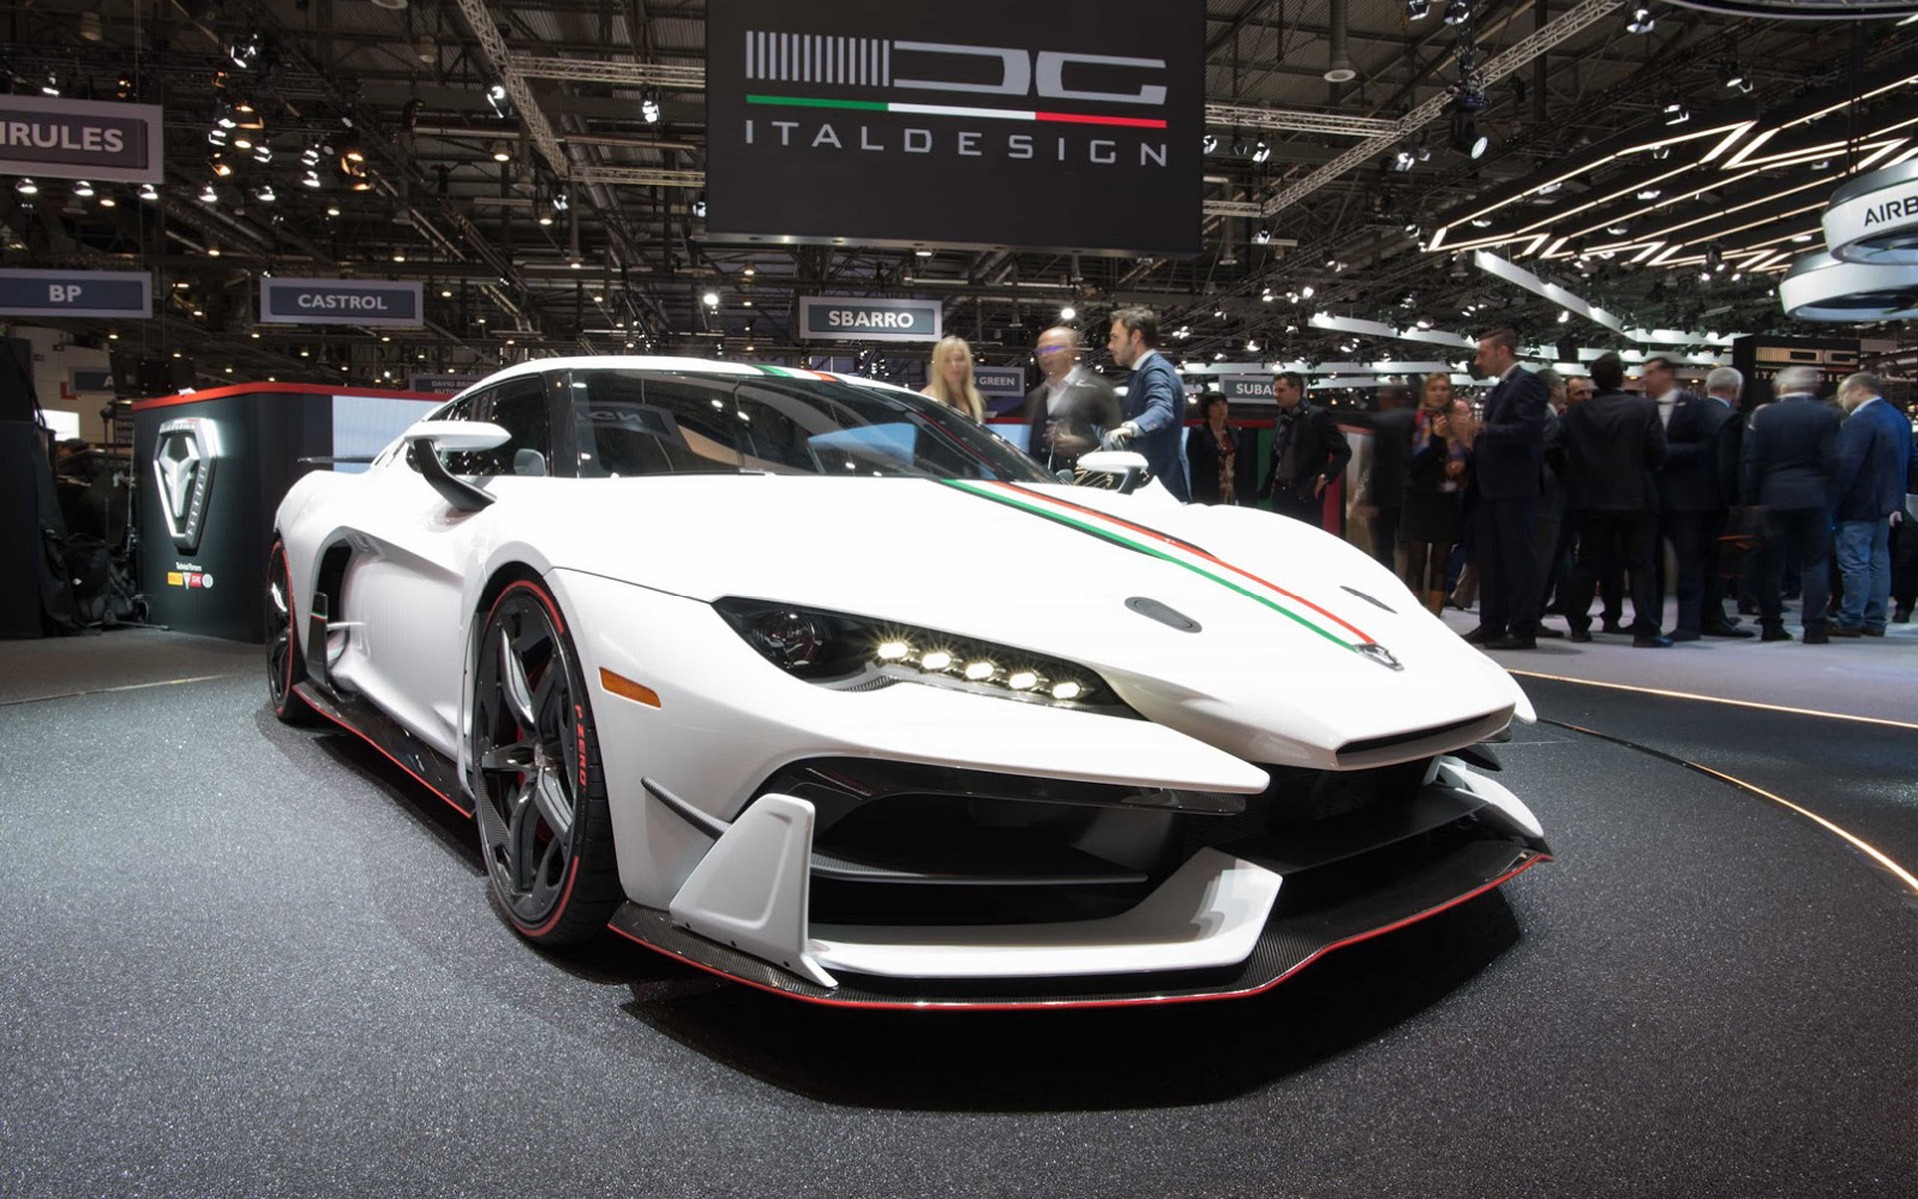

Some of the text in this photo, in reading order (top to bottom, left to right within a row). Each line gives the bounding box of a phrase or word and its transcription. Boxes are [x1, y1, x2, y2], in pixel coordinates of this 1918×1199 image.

[0, 121, 125, 153] RULES
[744, 118, 1168, 168] ITALDESIGN
[1864, 196, 1918, 227] AIRB
[48, 284, 82, 304] BP
[297, 293, 388, 311] CASTROL
[827, 309, 915, 330] SBARRO
[431, 380, 472, 388] DAVID BRO
[978, 376, 1015, 386] GREEN
[1235, 383, 1279, 396] SUBA
[575, 703, 587, 789] P ZERO
